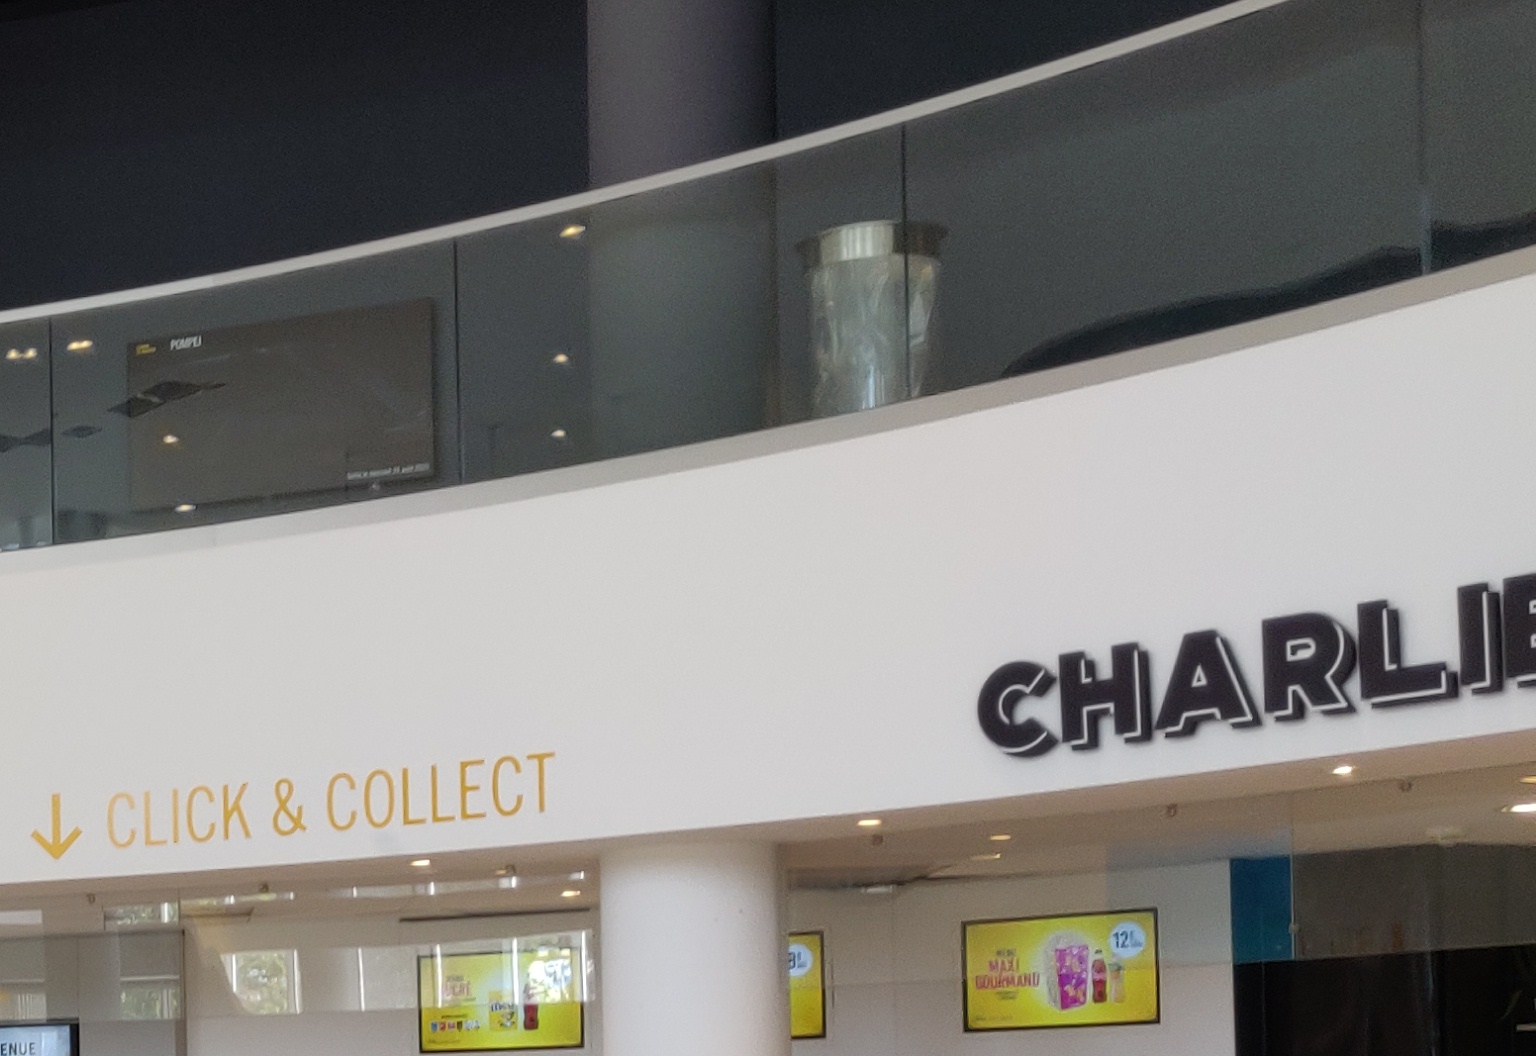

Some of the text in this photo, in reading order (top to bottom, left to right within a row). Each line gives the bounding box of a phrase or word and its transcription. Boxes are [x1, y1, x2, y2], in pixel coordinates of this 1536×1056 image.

[107, 752, 557, 849] CLICK & COLLECT
